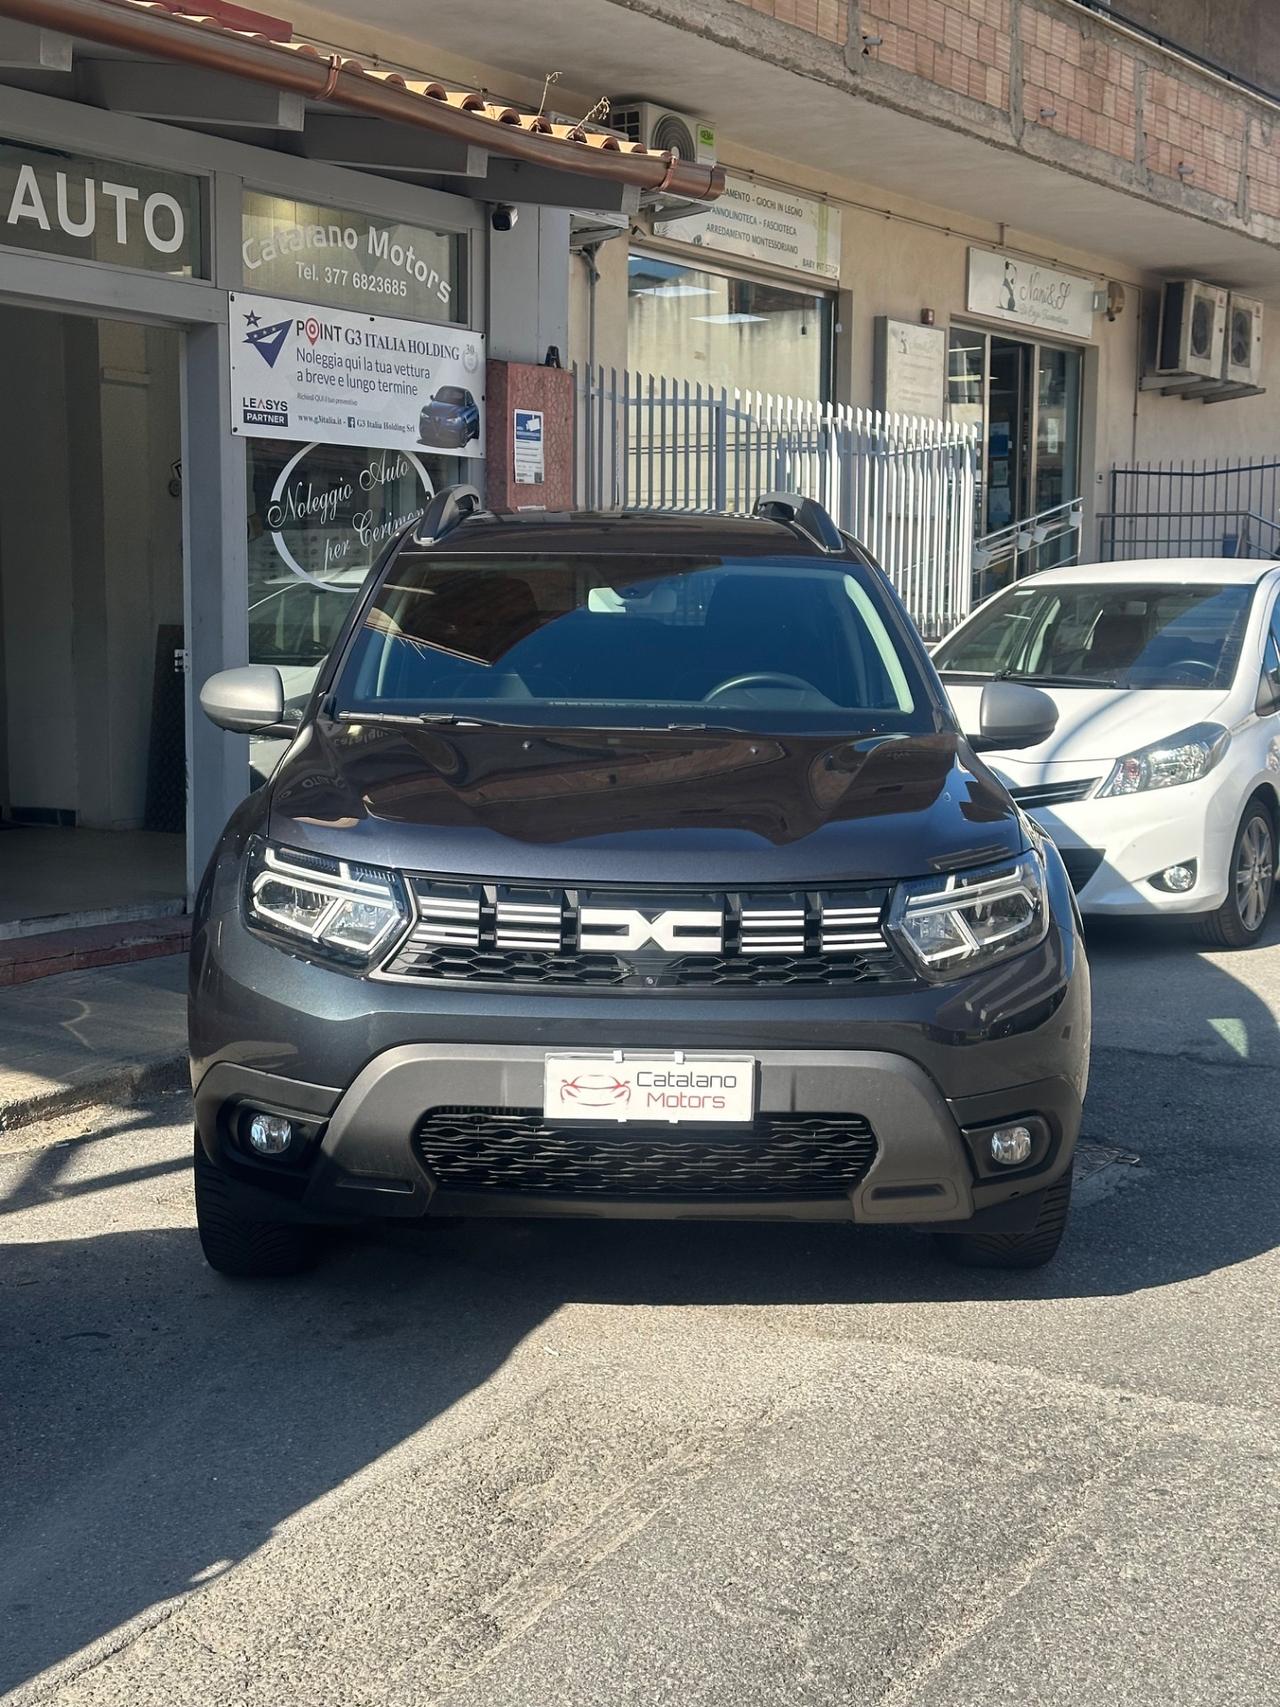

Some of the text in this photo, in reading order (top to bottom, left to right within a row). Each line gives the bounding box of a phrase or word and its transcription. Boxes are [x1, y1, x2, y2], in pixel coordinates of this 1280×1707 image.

[7, 164, 184, 253] AUTO
[725, 187, 751, 203] AMENTO
[756, 196, 777, 211] GIOCHI
[777, 201, 784, 212] IN
[784, 203, 803, 218] LEGNO
[710, 205, 758, 225] ANNOLINOTECA
[763, 218, 798, 237] FASCIOTECA
[706, 223, 799, 255] ARREDAMENTO MONTESSORIANO
[242, 223, 451, 304] Catalano Motors
[296, 261, 407, 297] Tel. 377 6823685
[802, 257, 815, 270] BABY
[345, 327, 362, 346] G3
[365, 333, 406, 353] ITALIA
[408, 339, 460, 361] HOLDING
[296, 347, 430, 379] Noleggia qui la tua vettura
[296, 368, 418, 396] a breve e lungo termine
[242, 397, 288, 412] LEASYS
[246, 411, 285, 424] PARTNER
[298, 414, 342, 425] www.g3italia.it
[357, 419, 366, 427] G3
[367, 420, 382, 430] Italia
[383, 421, 406, 433] Holding
[406, 424, 415, 433] Srl
[267, 449, 410, 528] Noleggio Auto
[324, 538, 350, 573] per
[636, 1071, 737, 1088] Catalano
[647, 1091, 726, 1109] Motors
